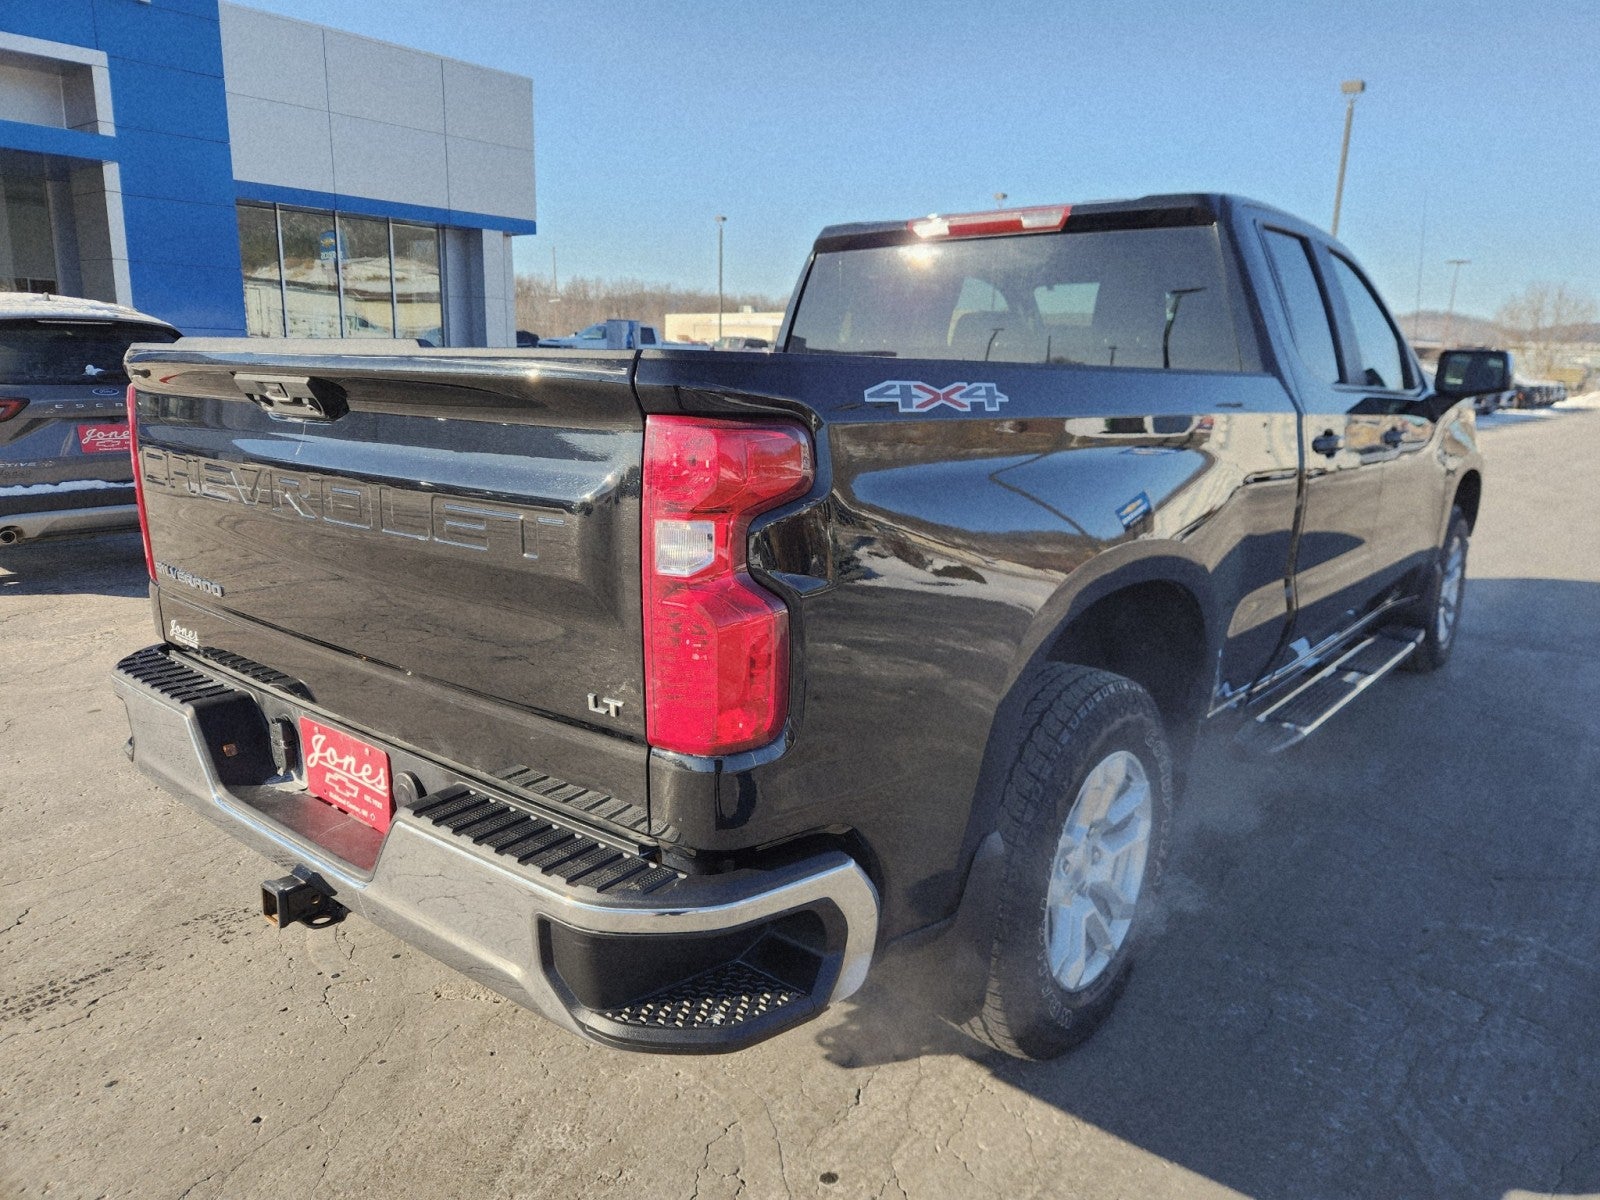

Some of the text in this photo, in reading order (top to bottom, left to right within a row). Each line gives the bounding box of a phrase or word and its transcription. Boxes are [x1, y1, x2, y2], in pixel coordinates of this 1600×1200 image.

[864, 380, 1009, 412] 4X4
[81, 428, 130, 445] Jone
[141, 446, 567, 559] CHEVROLET
[169, 619, 199, 642] Jones
[587, 692, 626, 718] LT
[307, 733, 388, 791] Jones
